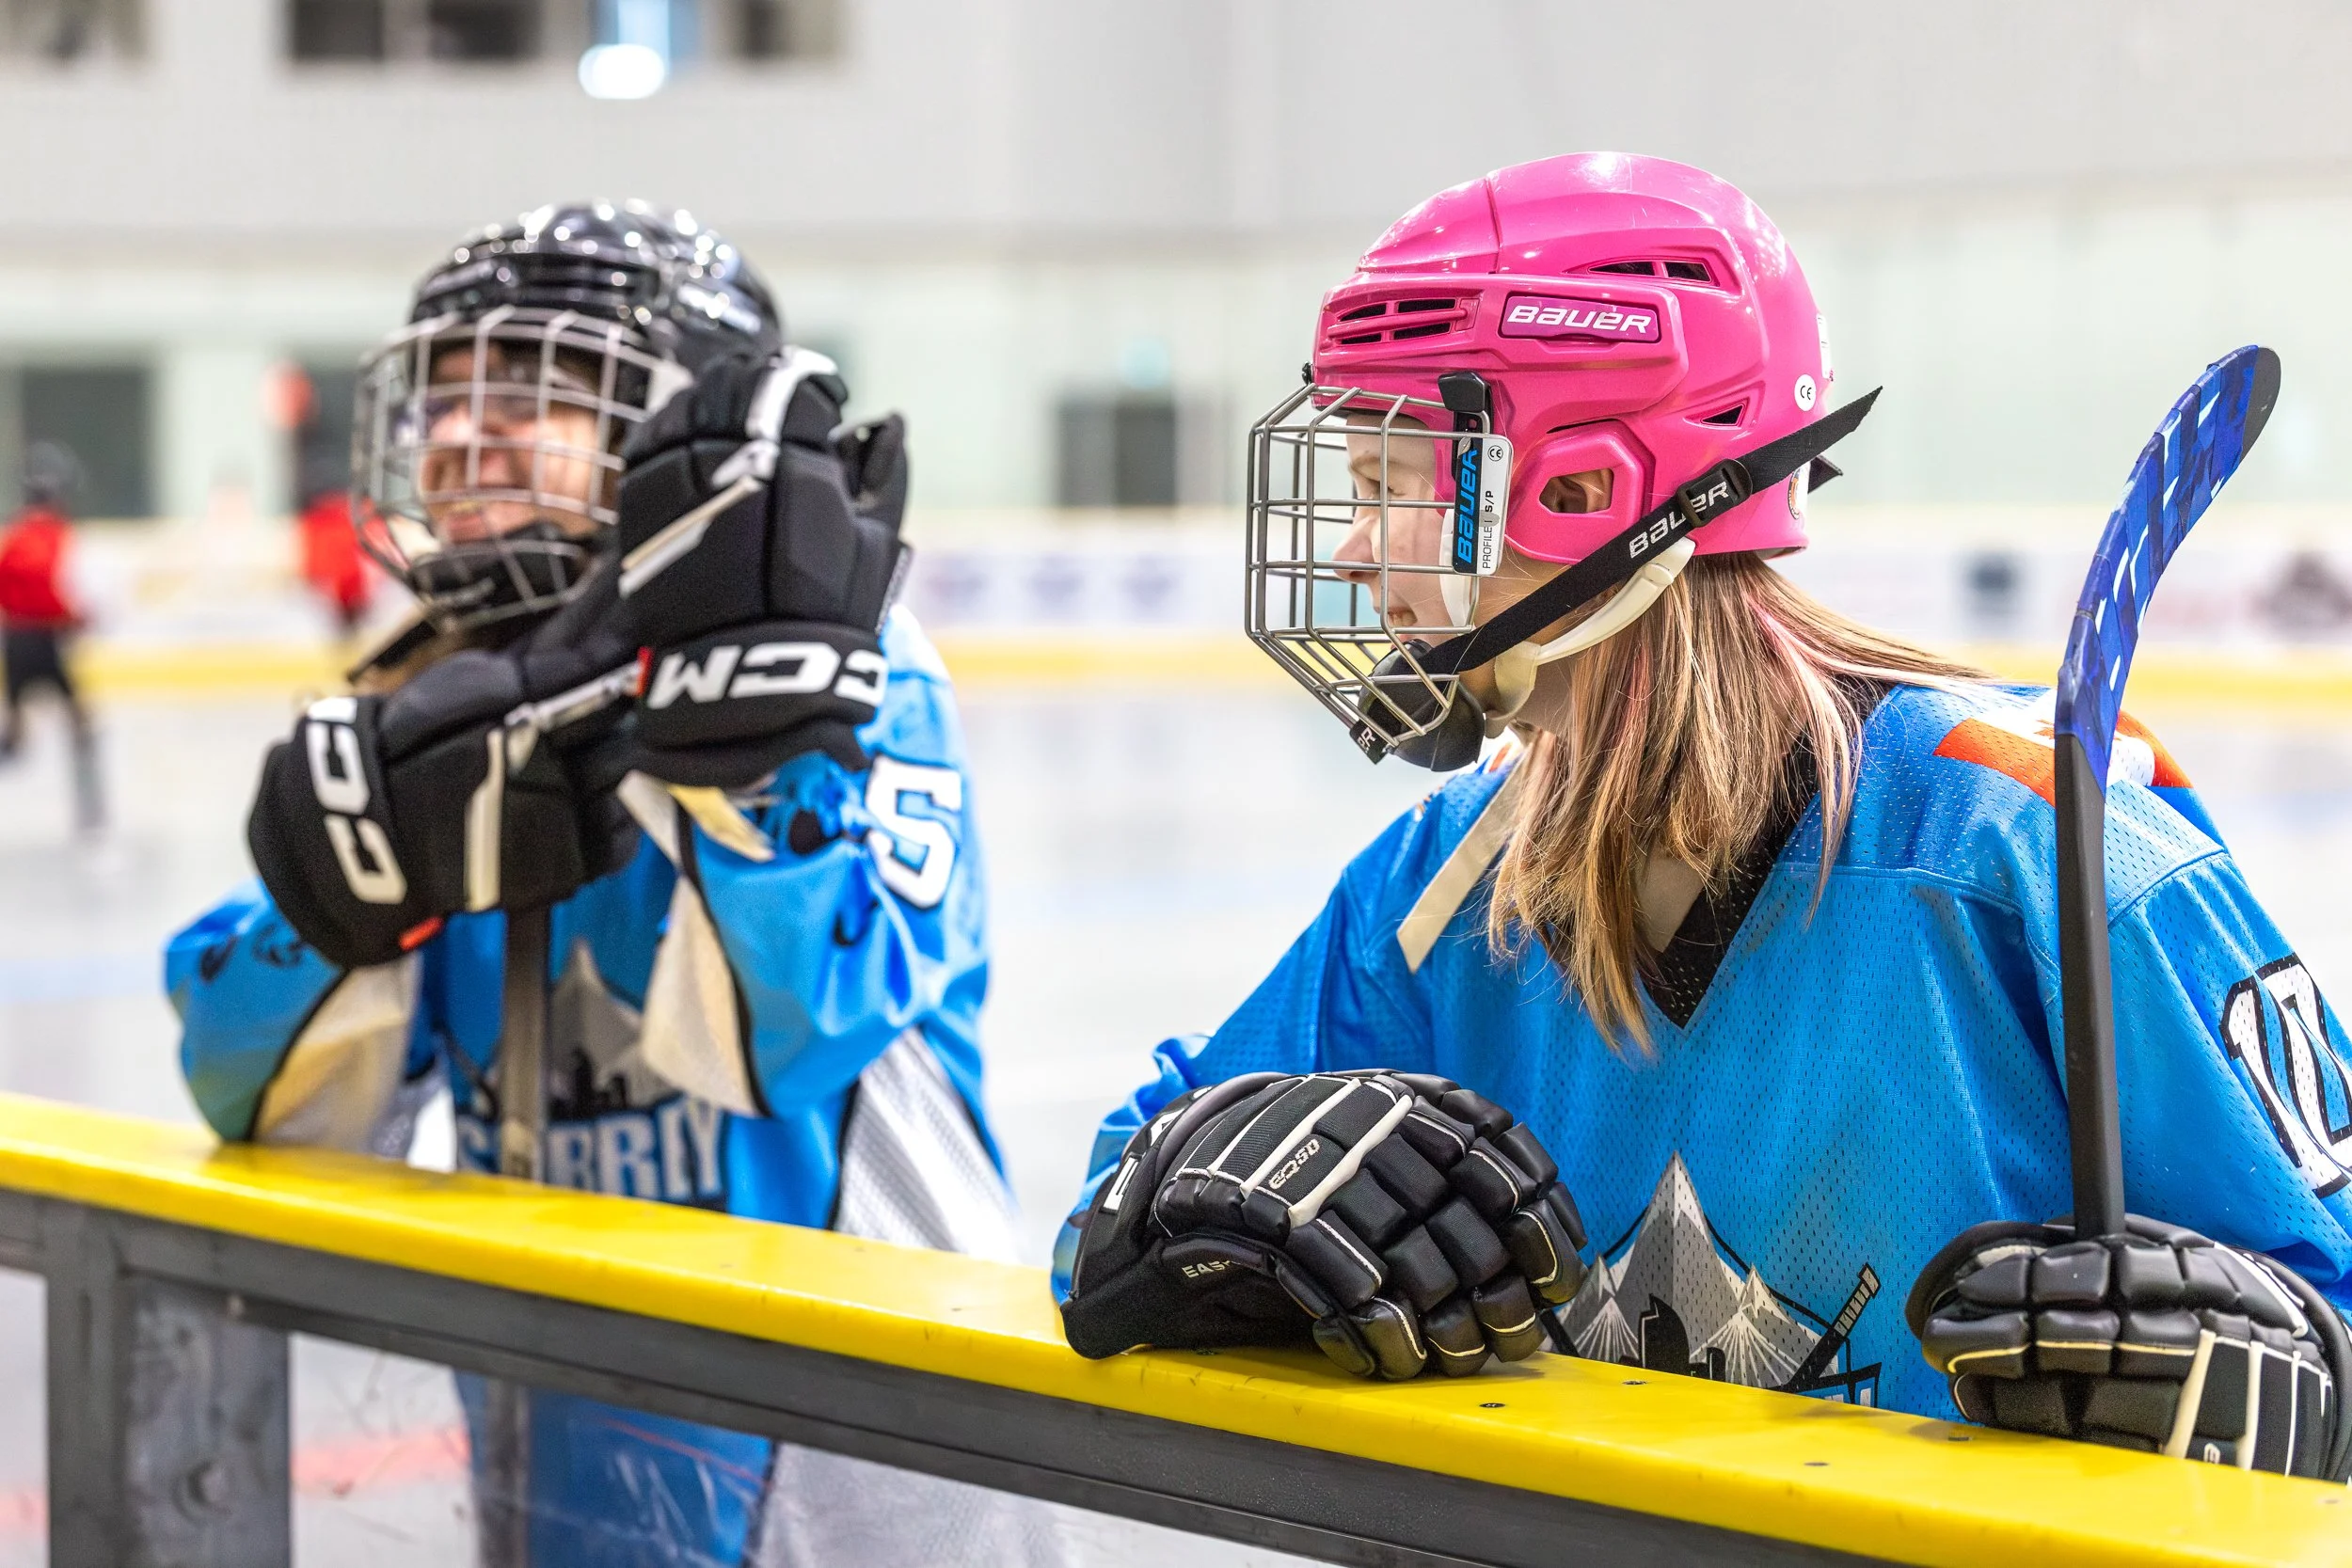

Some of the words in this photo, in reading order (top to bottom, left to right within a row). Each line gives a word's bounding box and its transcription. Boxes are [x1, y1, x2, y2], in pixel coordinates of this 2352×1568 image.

[1506, 305, 1652, 334] BAUER
[1458, 448, 1478, 563] BAUER
[1485, 490, 1495, 513] S/P
[1483, 527, 1493, 569] PROFILE
[646, 641, 889, 710] CCM
[865, 752, 963, 911] 5
[2218, 951, 2352, 1199] 10
